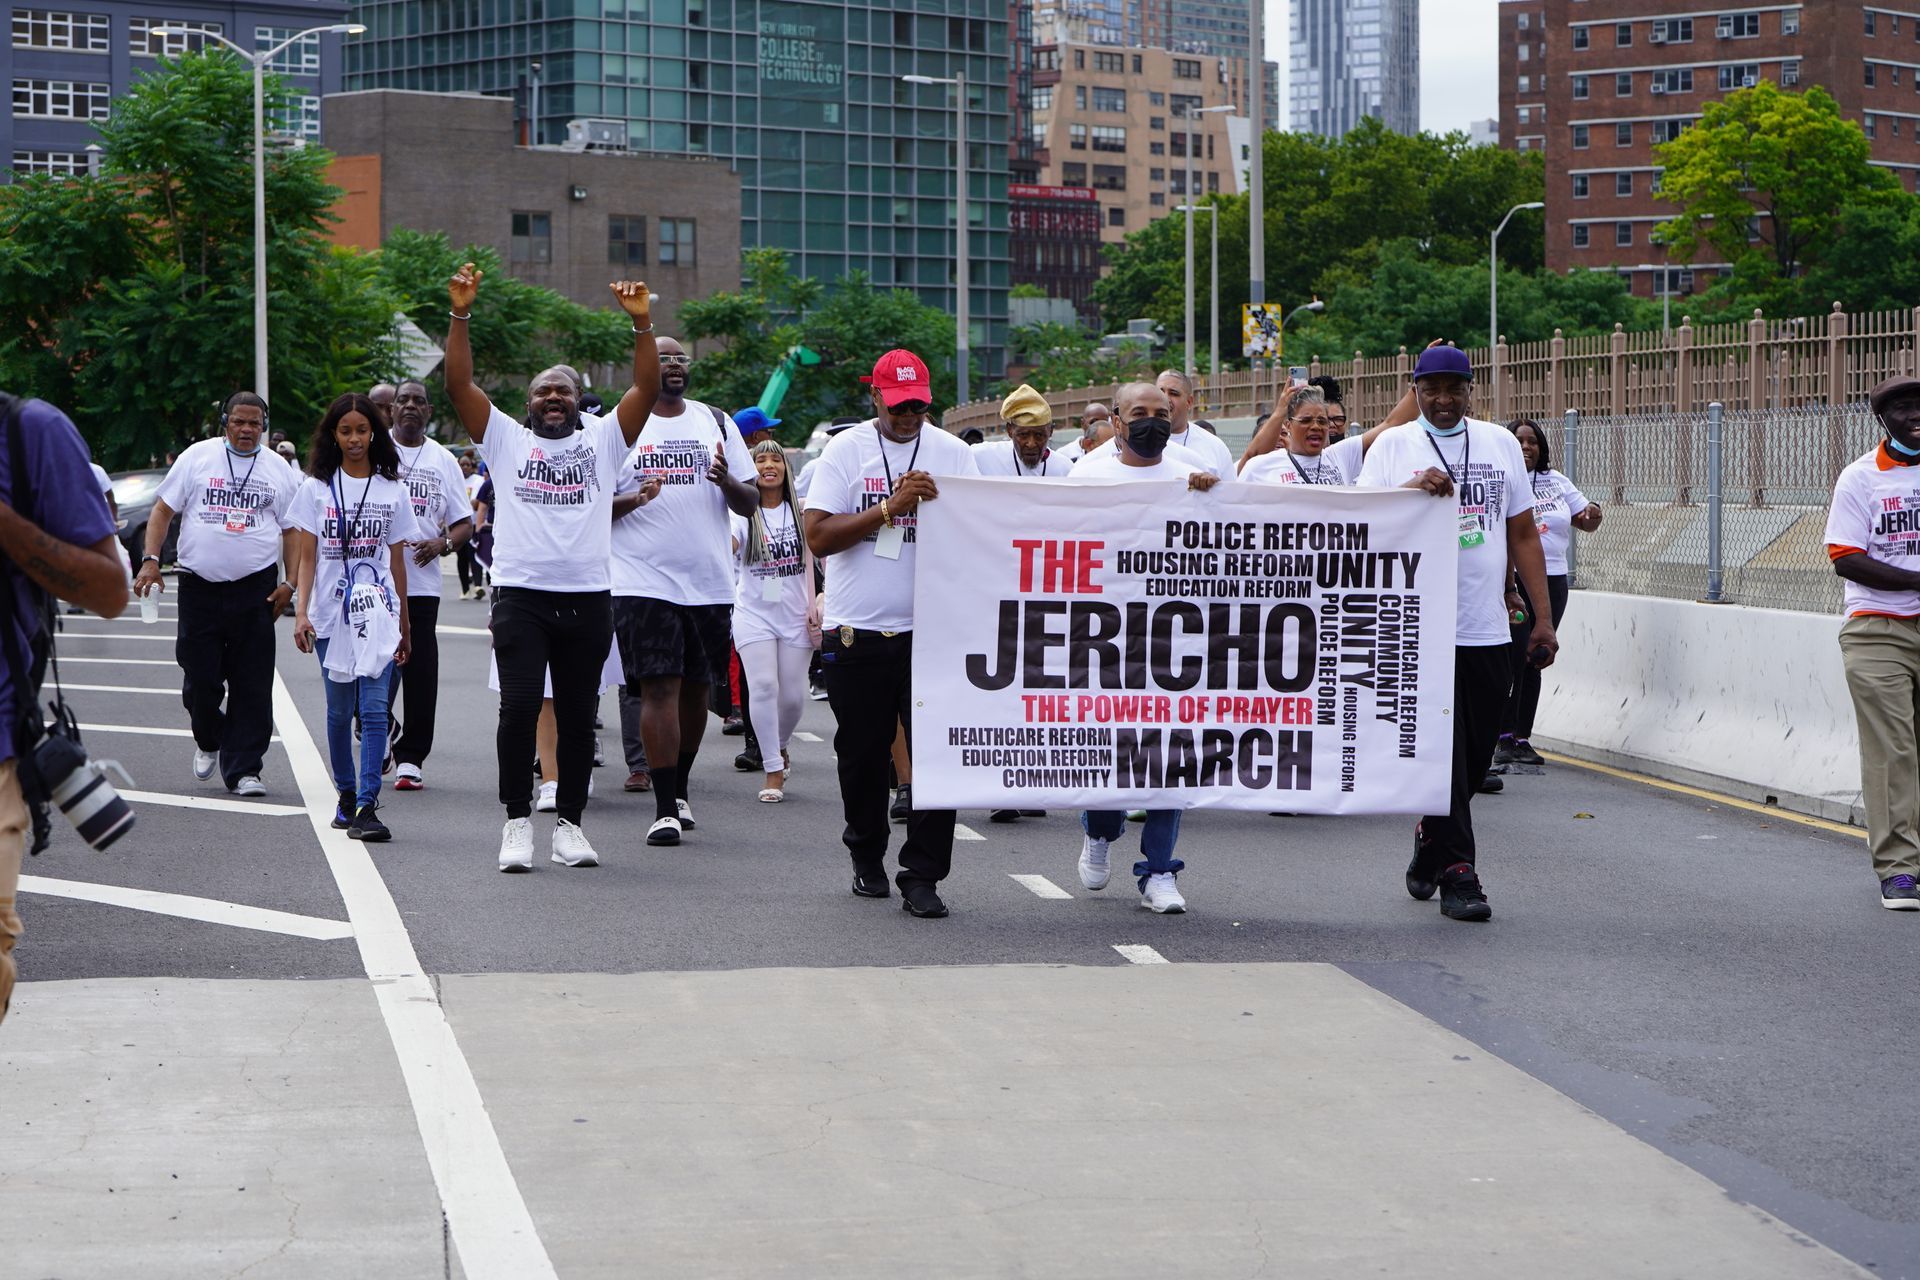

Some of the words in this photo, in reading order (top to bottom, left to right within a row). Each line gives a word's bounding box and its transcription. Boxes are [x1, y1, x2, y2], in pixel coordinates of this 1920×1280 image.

[760, 37, 815, 61] COLLEGE
[760, 59, 842, 84] TECHNOLOGY
[634, 453, 693, 470] JERICHO
[639, 444, 655, 454] THE
[209, 477, 225, 488] THE
[518, 459, 584, 486] JERICHO
[864, 477, 886, 492] THE
[1280, 472, 1296, 483] THE
[1482, 470, 1505, 480] UNITY
[202, 487, 260, 509] JERICHO
[542, 489, 584, 505] MARCH
[1489, 480, 1497, 505] UNITY
[1881, 496, 1903, 511] THE
[1165, 520, 1256, 550] POLICE
[1263, 522, 1369, 550] REFORM
[1463, 533, 1479, 542] VIP
[1900, 532, 1919, 540] POWER
[1012, 539, 1105, 593] THE
[1117, 551, 1218, 576] HOUSING
[1224, 553, 1314, 577] REFORM
[1316, 552, 1422, 589] UNITY
[1146, 578, 1240, 597] EDUCATION
[1244, 579, 1312, 598] REFORM
[1319, 593, 1340, 651] POLICE
[965, 599, 1317, 693] JERICHO
[1340, 594, 1378, 689] UNITY
[1401, 594, 1421, 691] HEALTHCARE
[1375, 594, 1402, 724] COMMUNITY
[1317, 656, 1337, 725] REFORM
[1021, 695, 1070, 722] THE
[1077, 695, 1171, 723] POWER
[1178, 696, 1210, 724] OF
[1216, 696, 1313, 725] PRAYER
[1342, 687, 1358, 741] HOUSING
[948, 727, 1045, 746] HEALTHCARE
[1049, 727, 1112, 746] REFORM
[1398, 695, 1417, 758] REFORM
[962, 749, 1047, 766] EDUCATION
[1050, 749, 1112, 766] REFORM
[1116, 728, 1313, 791] MARCH
[1341, 746, 1356, 792] REFORM
[1002, 768, 1110, 788] COMMUNITY
